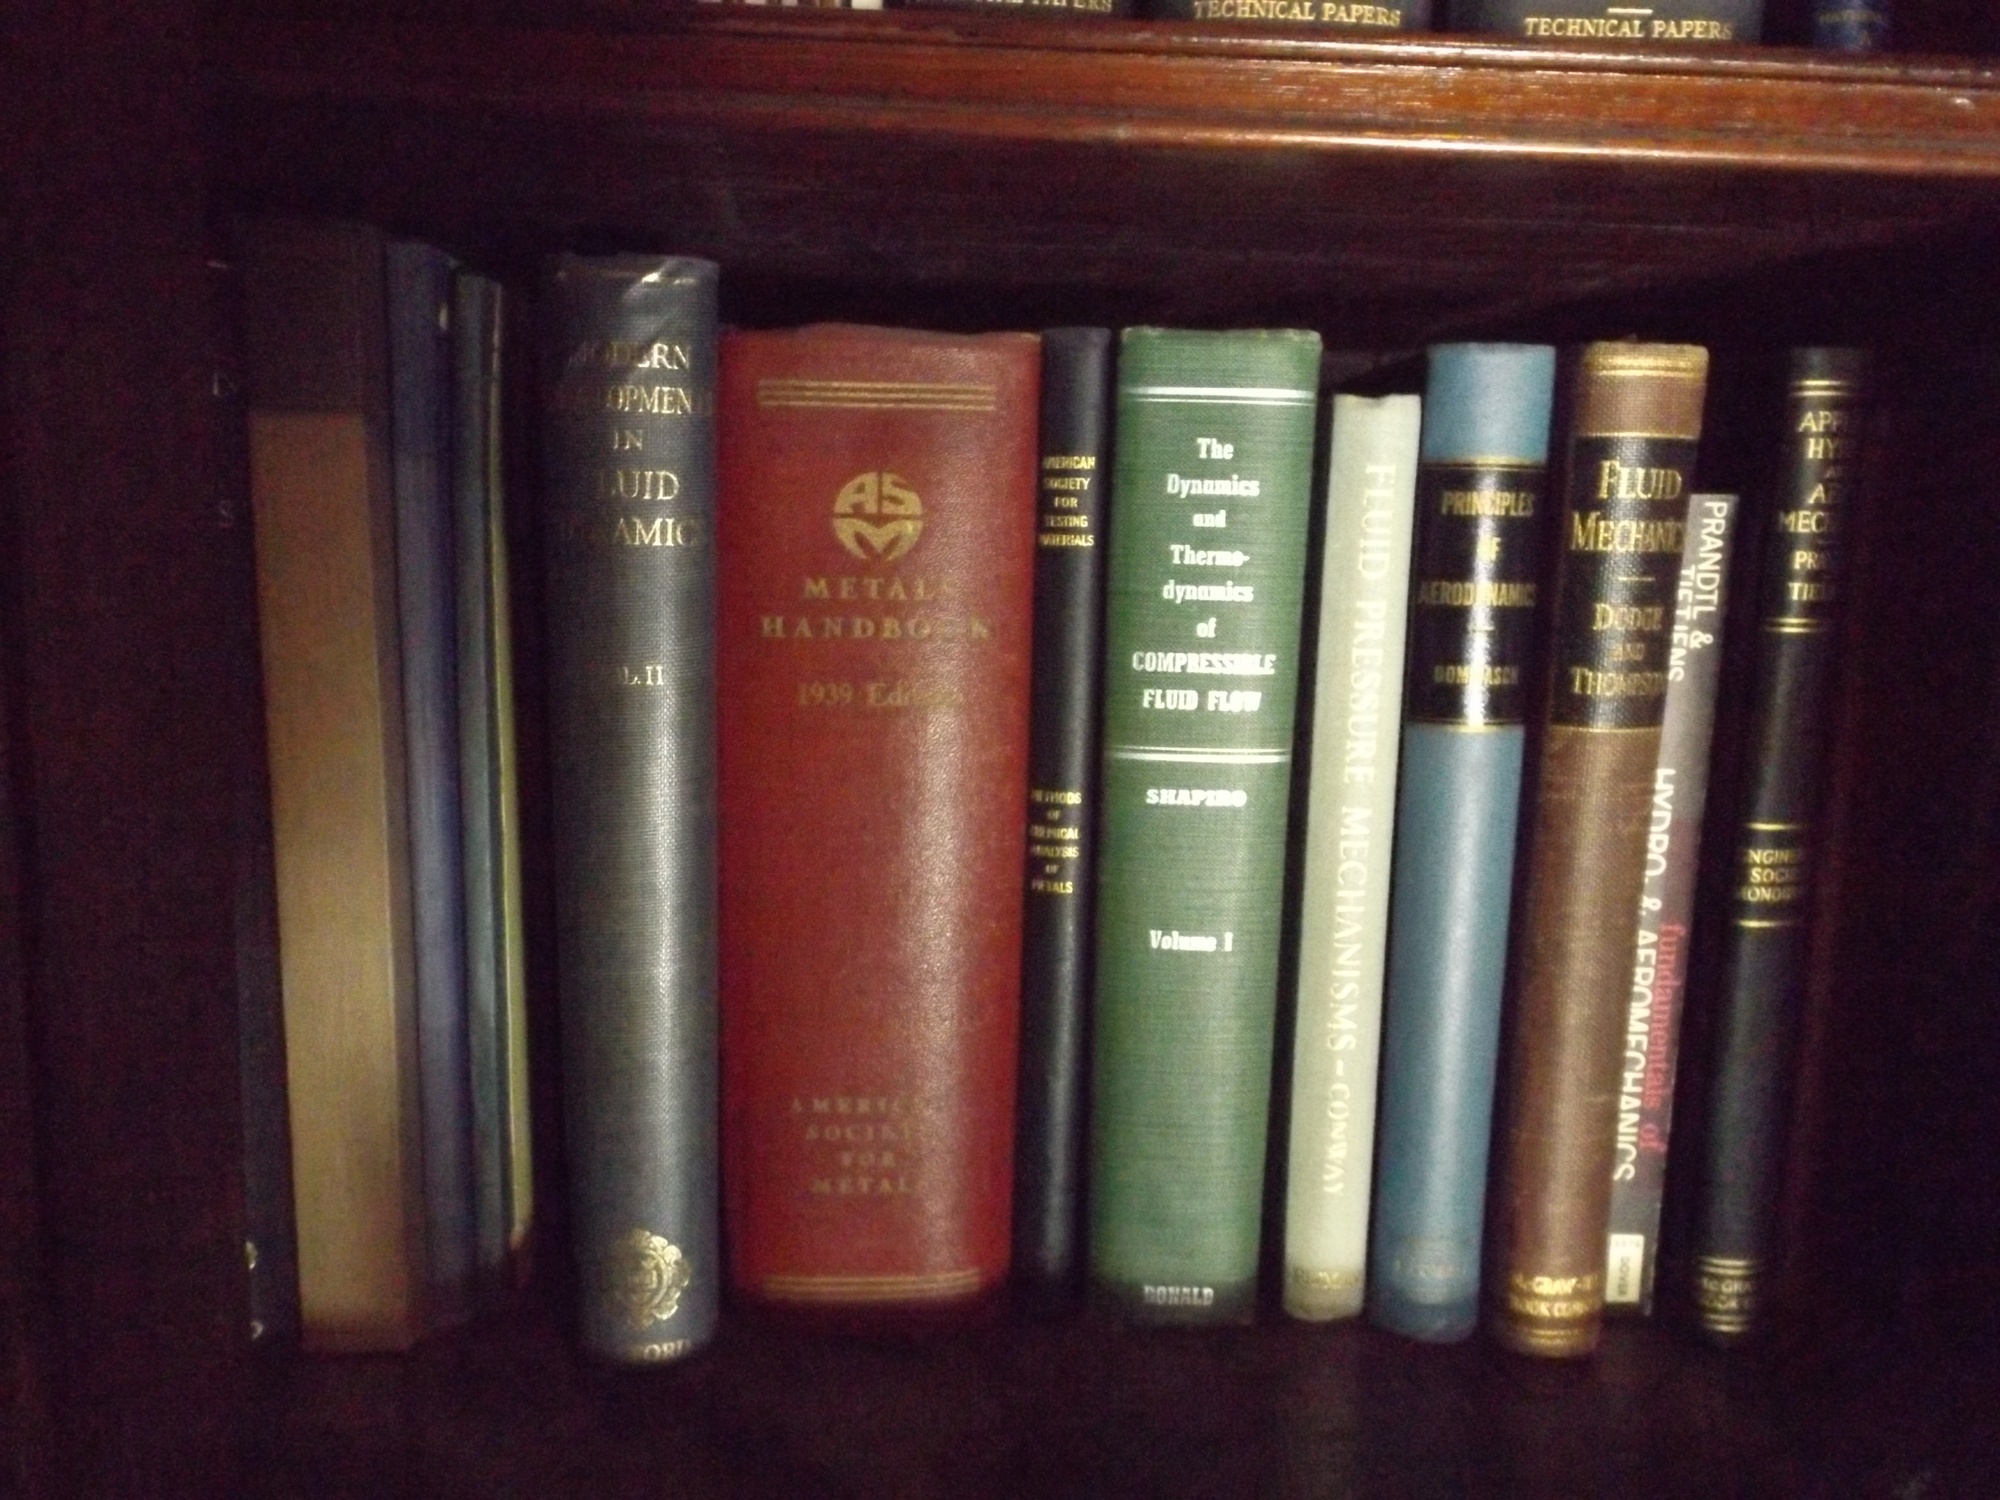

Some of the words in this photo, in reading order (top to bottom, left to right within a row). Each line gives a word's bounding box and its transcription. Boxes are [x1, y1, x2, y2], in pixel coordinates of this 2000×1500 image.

[1194, 0, 1315, 21] TECHNICAL
[1322, 3, 1402, 26] PAPERS
[1525, 17, 1645, 37] TECHNICAL
[1652, 19, 1733, 40] PAPERS
[1197, 437, 1235, 460] The
[1166, 473, 1261, 499] Dynamics
[1598, 458, 1684, 500] FLUID
[1053, 496, 1079, 508] FOR
[1192, 509, 1227, 528] and
[1357, 462, 1397, 579] FLUID
[1169, 544, 1251, 567] Thermo-
[1691, 501, 1729, 621] PRANDTL
[1162, 579, 1255, 604] dynamics
[761, 615, 990, 640] HANDBOK
[1196, 617, 1218, 638] of
[1689, 630, 1714, 650] &
[645, 666, 665, 685] II
[1131, 651, 1277, 676] COMPRESSIBLE
[1142, 688, 1200, 711] FLUID
[1207, 690, 1263, 713] FLOW
[1343, 599, 1387, 785] PRESSURE
[1145, 788, 1248, 808] SHAPIRO
[1149, 929, 1217, 952] Volume
[1326, 805, 1373, 1052] MECHANISMS
